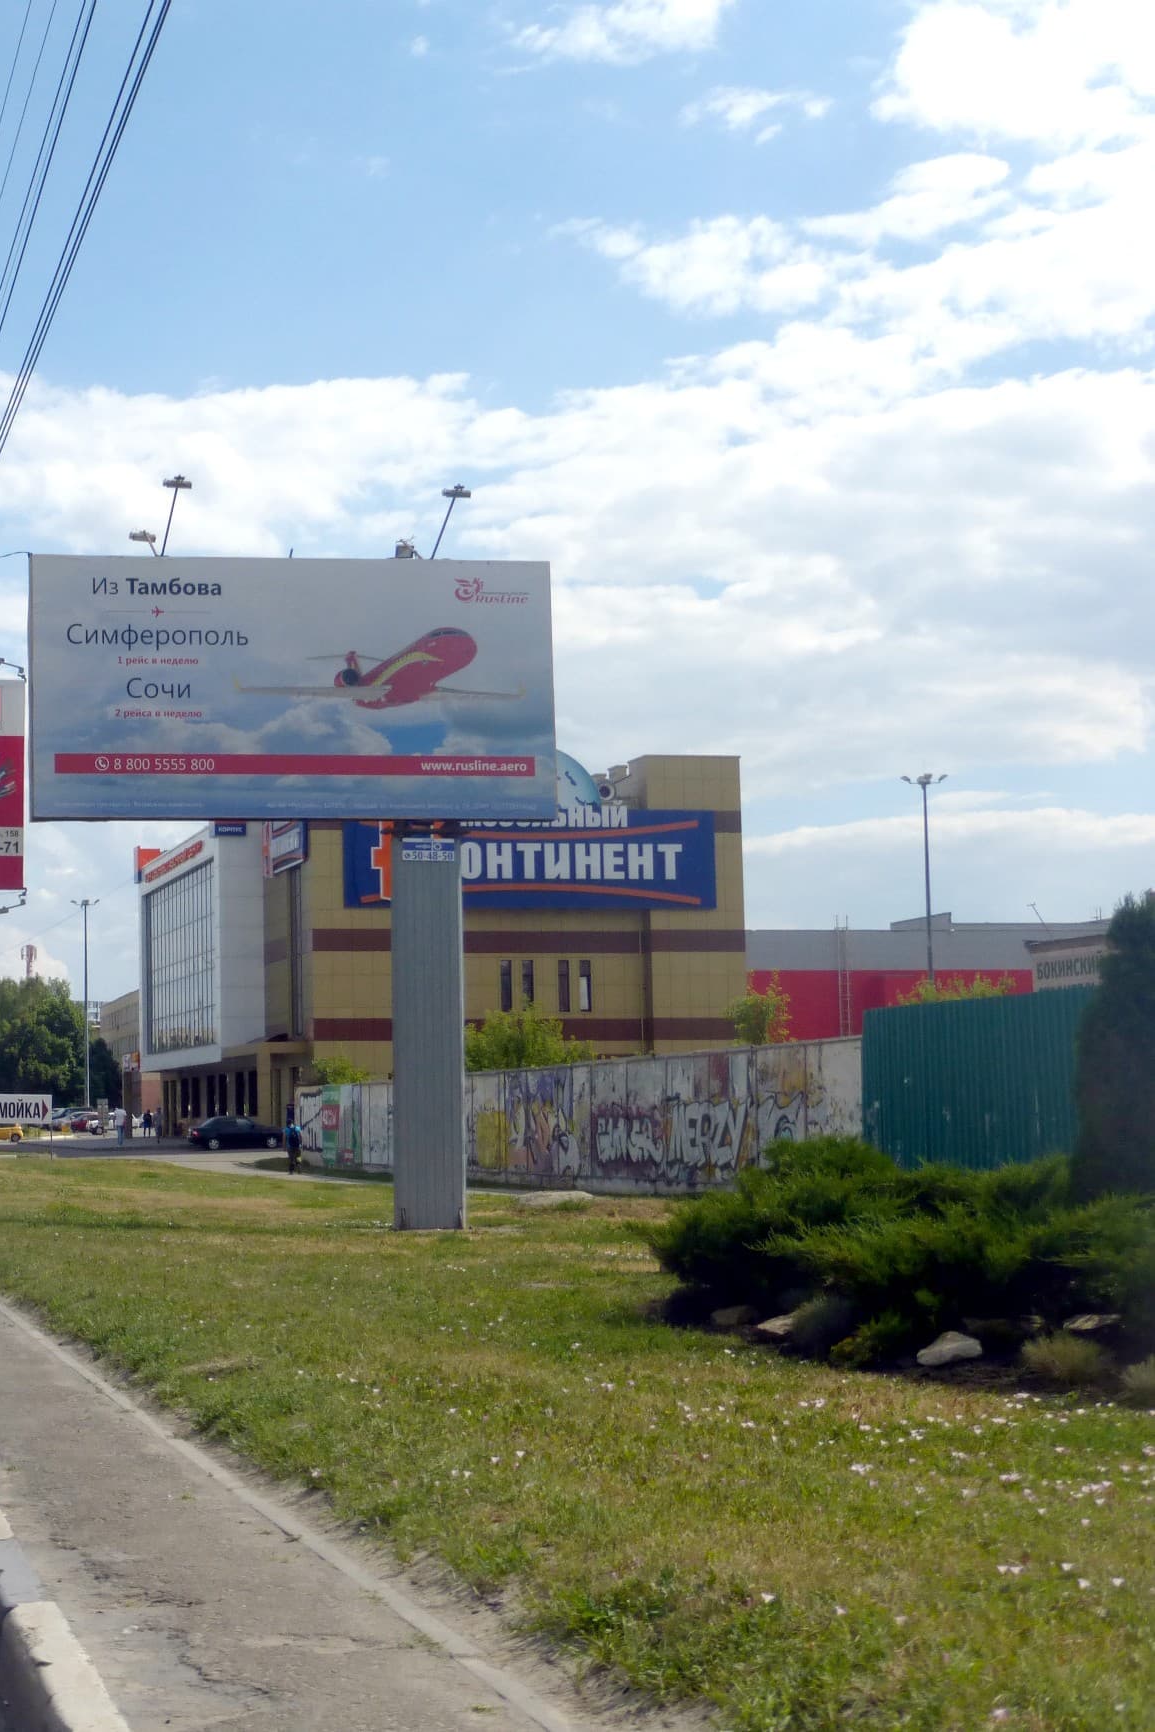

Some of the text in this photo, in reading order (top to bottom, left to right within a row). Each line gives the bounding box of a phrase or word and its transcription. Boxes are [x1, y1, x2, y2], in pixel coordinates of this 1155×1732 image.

[92, 577, 222, 596] Из Тамбова
[66, 623, 249, 651] Симферополь
[117, 656, 123, 664] 1
[125, 656, 149, 667] рейс
[160, 657, 199, 666] неделю
[126, 677, 191, 699] Сочи
[115, 709, 121, 717] 2
[123, 709, 152, 720] рейса
[163, 710, 202, 719] неделю
[113, 758, 215, 771] 8 800 5555 800
[421, 760, 527, 772] www.rusline.aero
[5, 830, 19, 838] 158
[459, 841, 684, 881] ОНТИНЕНТ
